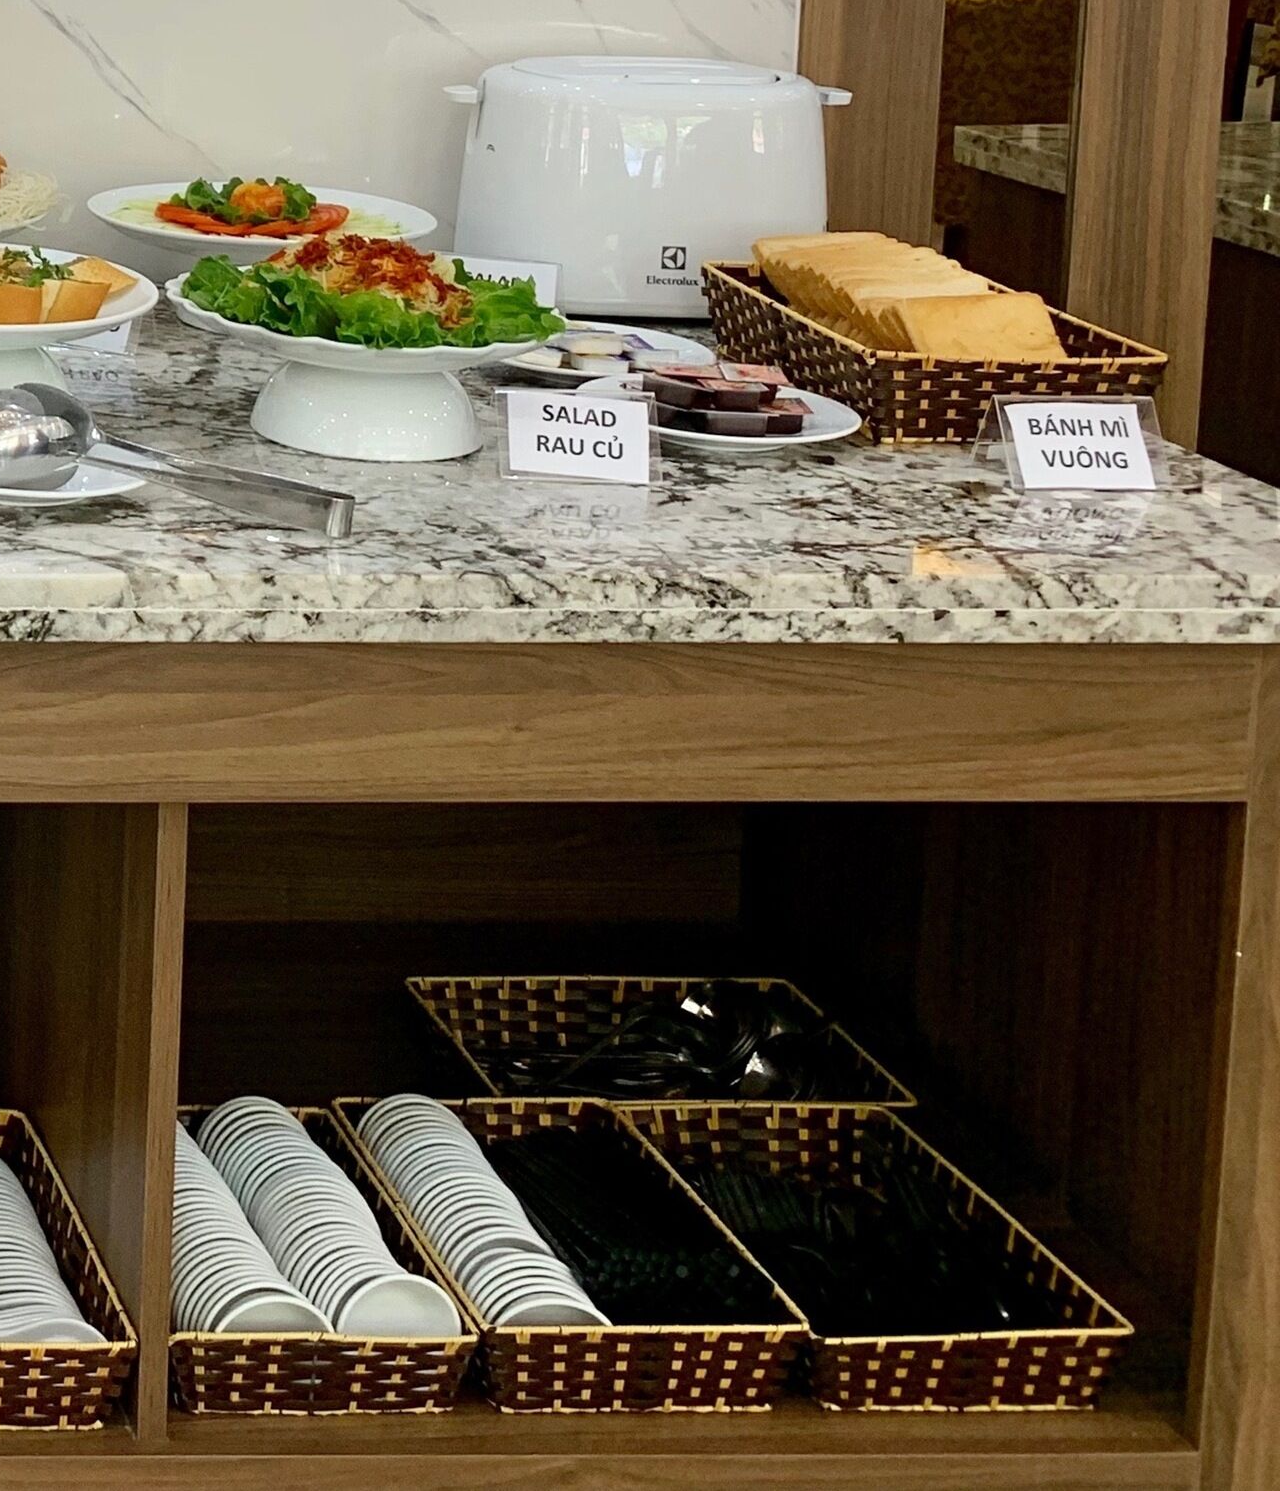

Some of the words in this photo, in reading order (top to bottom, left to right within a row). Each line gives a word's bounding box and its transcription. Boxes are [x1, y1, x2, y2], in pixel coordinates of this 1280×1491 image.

[646, 275, 699, 286] Electrolux
[542, 404, 617, 427] SALAD
[1027, 413, 1094, 437] BÁNH
[1100, 416, 1130, 438] MÌ
[536, 435, 585, 456] RAU
[592, 435, 624, 460] CỦ
[1041, 445, 1129, 470] VUÔNG
